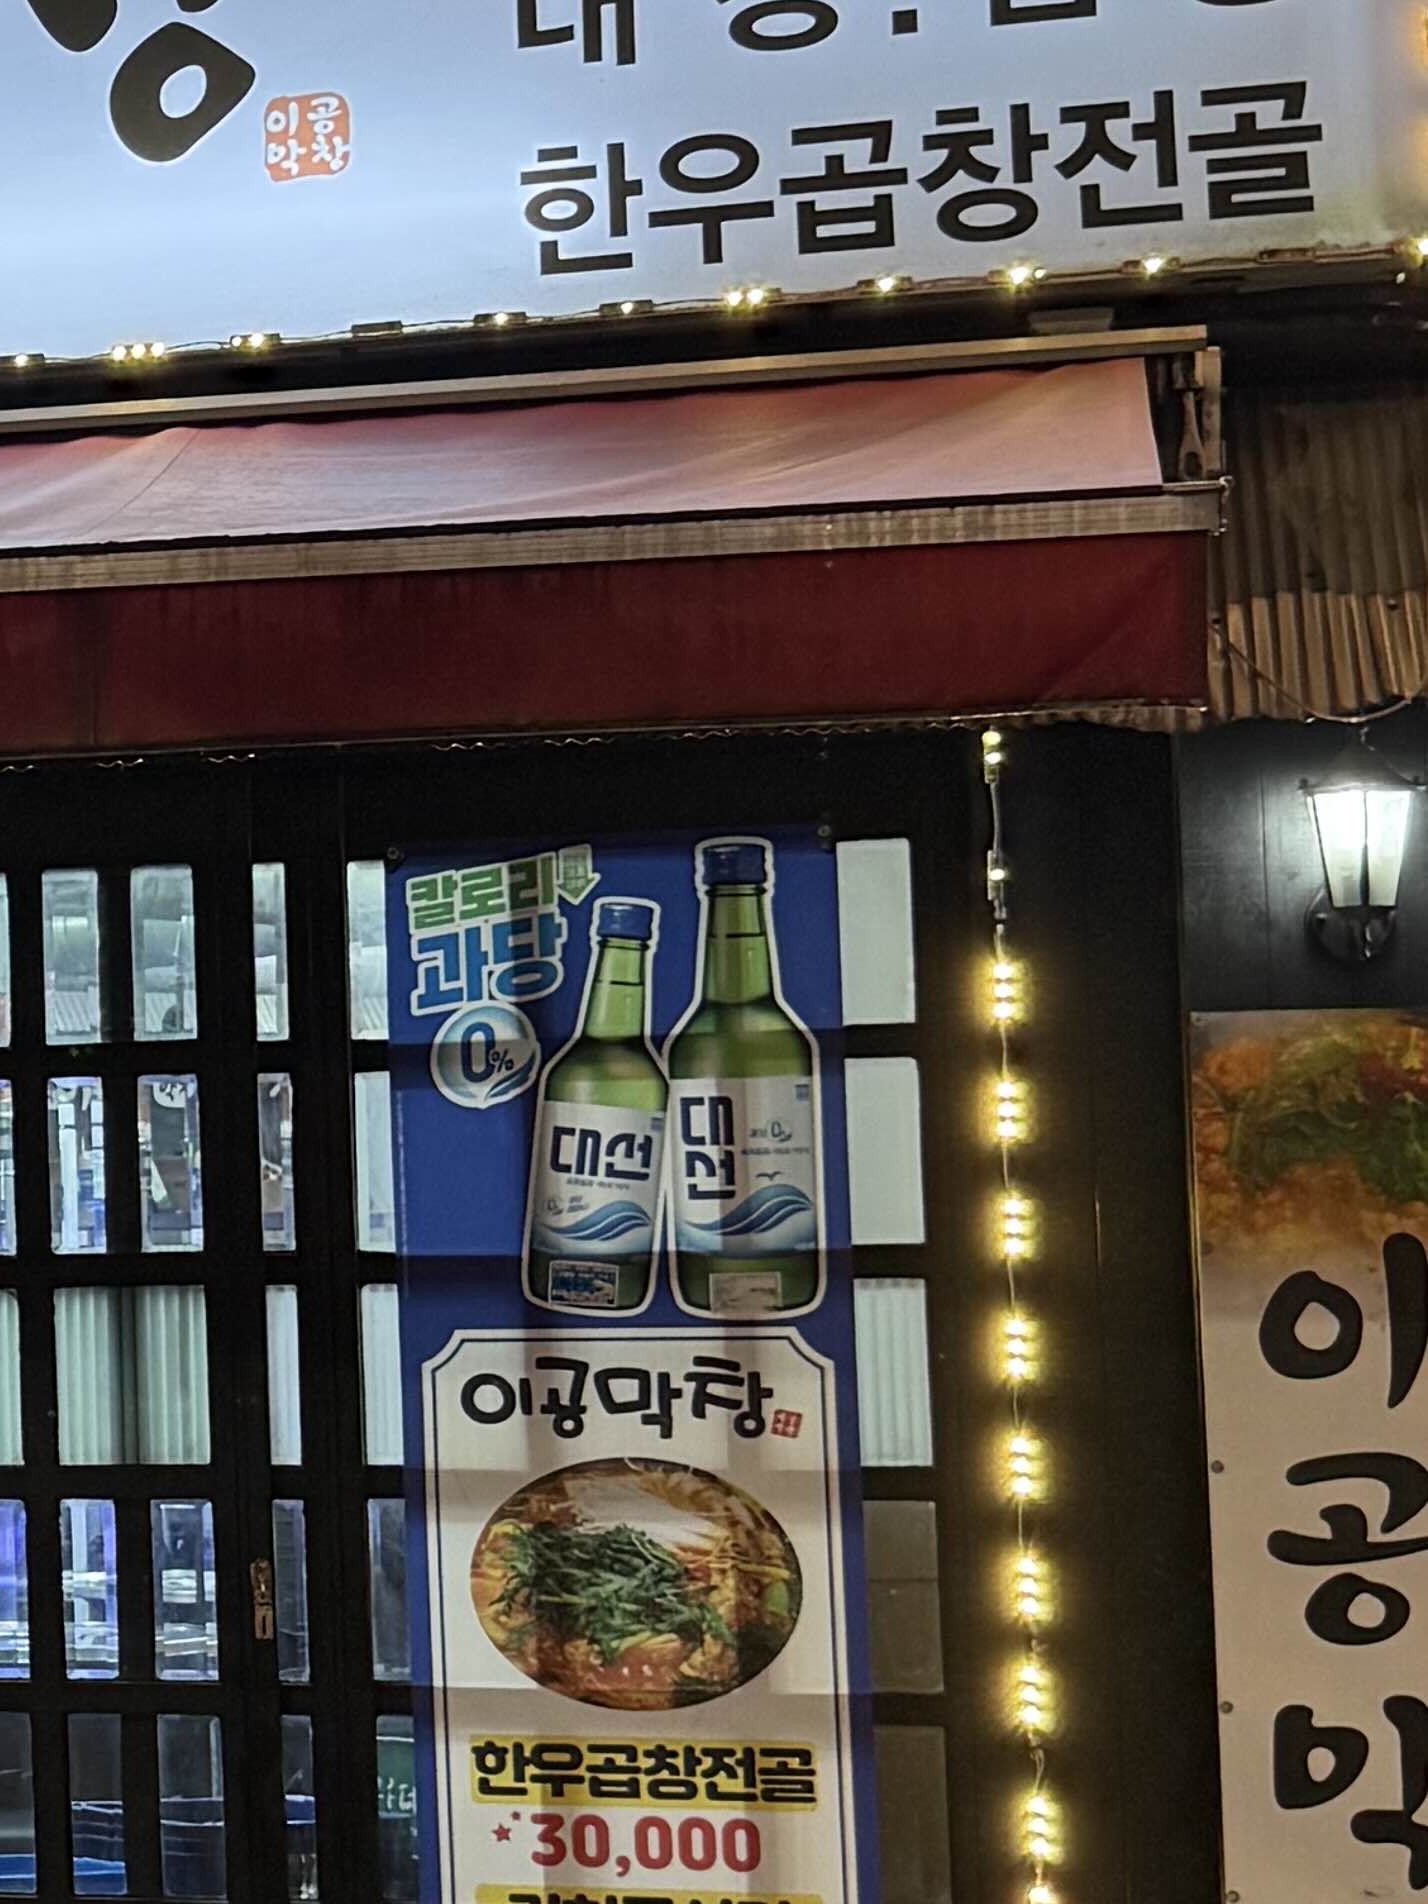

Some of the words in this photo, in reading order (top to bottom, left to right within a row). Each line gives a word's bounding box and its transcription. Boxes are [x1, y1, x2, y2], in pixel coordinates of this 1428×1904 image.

[519, 81, 1323, 276] 한우곱창전골
[411, 856, 555, 930] 칼로리
[417, 912, 562, 1009] 과당
[461, 1021, 514, 1083] 0%
[550, 1126, 653, 1181] 대선
[680, 1096, 736, 1200] 대선
[461, 1356, 774, 1440] 이공막창
[471, 1741, 817, 1803] 한우곱창전골
[530, 1813, 761, 1877] 30,000
